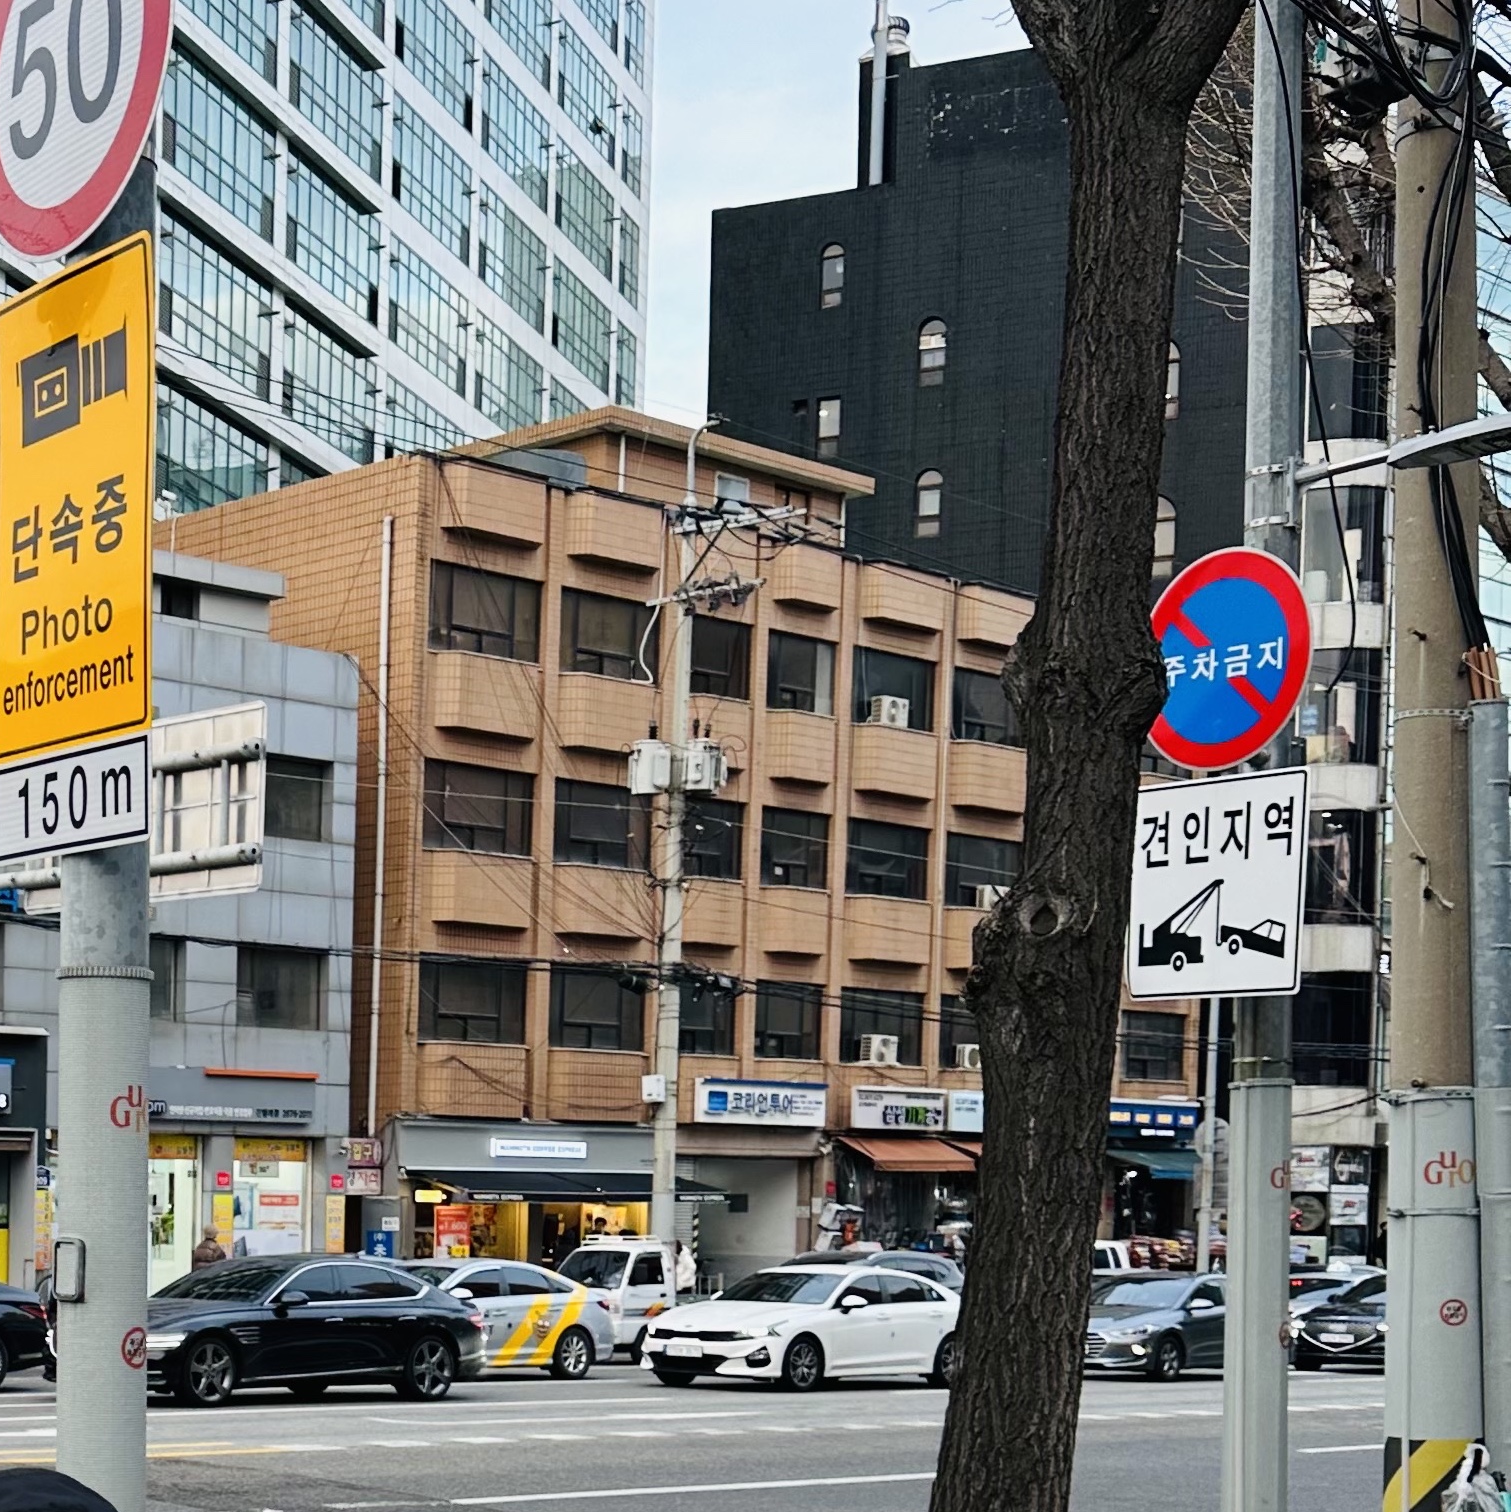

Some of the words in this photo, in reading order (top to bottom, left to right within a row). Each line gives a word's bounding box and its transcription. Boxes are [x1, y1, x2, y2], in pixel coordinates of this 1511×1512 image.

[9, 0, 122, 160] 50
[11, 473, 128, 584] 단속중
[20, 594, 113, 655] Photo
[3, 645, 134, 716] enforcement
[1164, 635, 1284, 688] 주차금지
[18, 765, 88, 839] 150
[101, 763, 132, 818] m
[1140, 795, 1295, 870] 견인지역
[731, 1092, 792, 1114] 코리언투어
[1423, 1151, 1476, 1189] Guro
